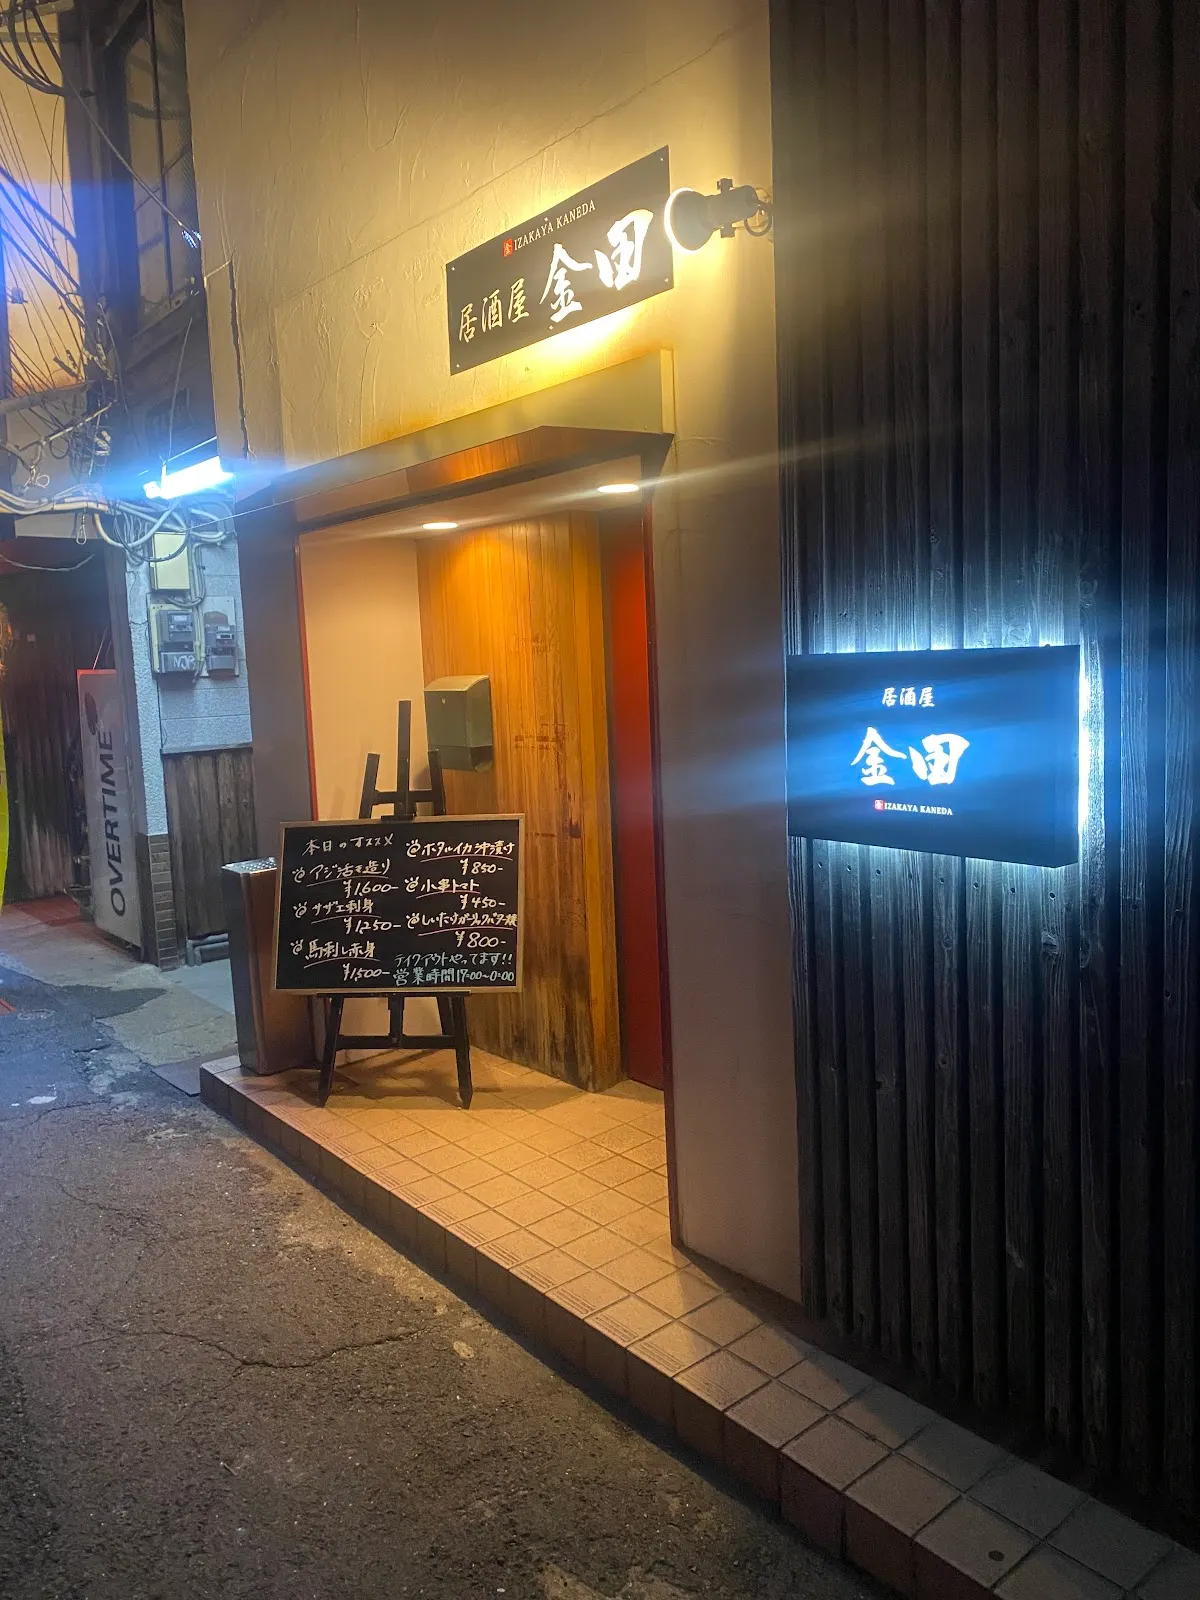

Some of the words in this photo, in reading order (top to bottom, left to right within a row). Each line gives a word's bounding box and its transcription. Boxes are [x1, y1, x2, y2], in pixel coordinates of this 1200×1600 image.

[514, 222, 554, 251] IZAKAYA
[556, 200, 596, 229] KANEDA
[458, 277, 530, 343] 居酒屋
[539, 208, 654, 324] 金田
[881, 686, 935, 708] 居酒屋
[850, 726, 970, 786] 金田
[97, 730, 126, 917] OVERTIME
[884, 802, 918, 812] IZAKAYA
[920, 805, 953, 815] KANEDA
